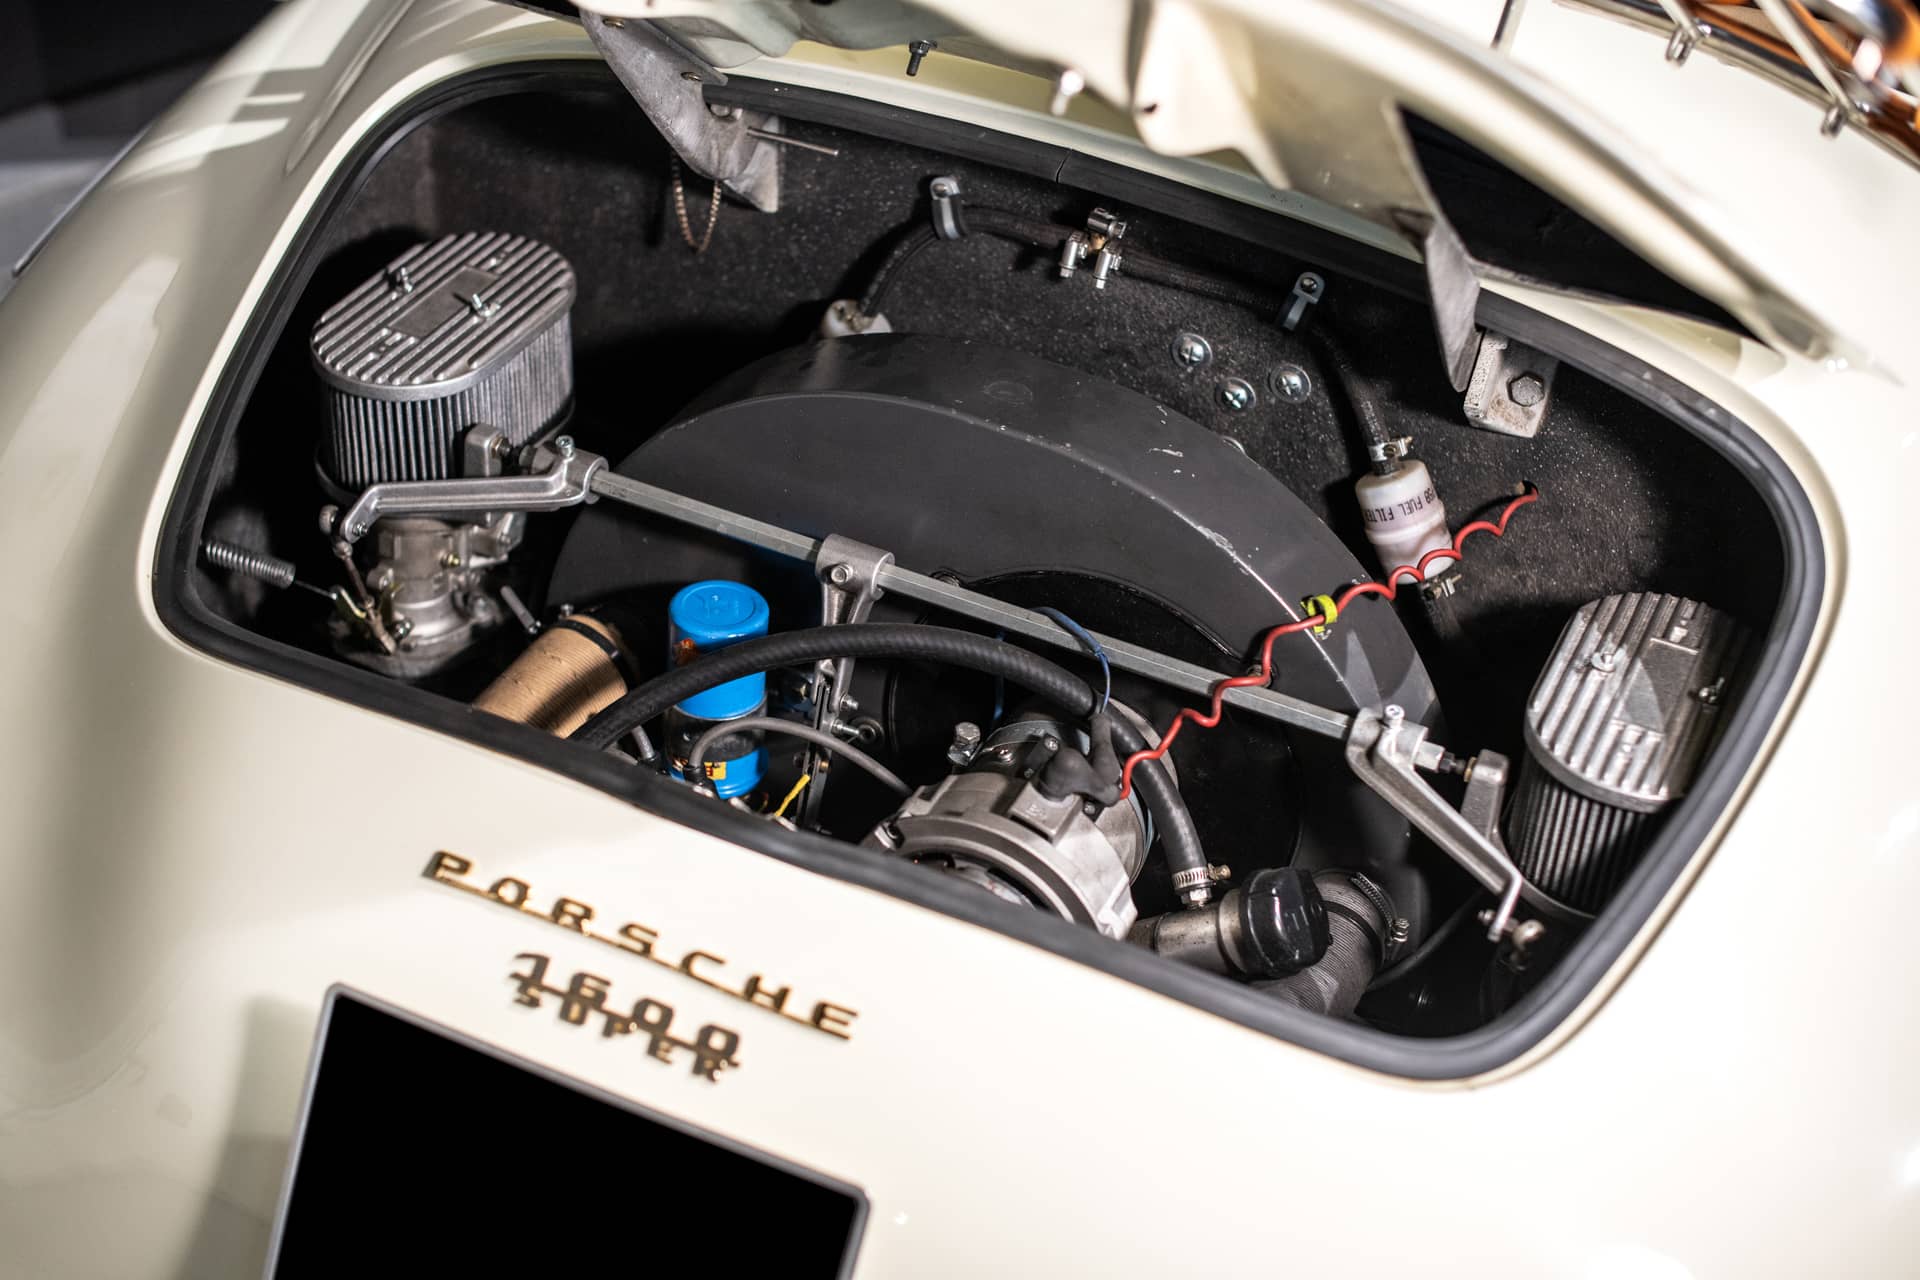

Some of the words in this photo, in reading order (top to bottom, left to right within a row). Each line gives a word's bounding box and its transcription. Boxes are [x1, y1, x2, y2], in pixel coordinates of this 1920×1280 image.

[1398, 496, 1423, 516] FUEL
[421, 850, 859, 1041] PORSCHE
[509, 952, 740, 1060] 1600
[514, 982, 730, 1082] SUPER
